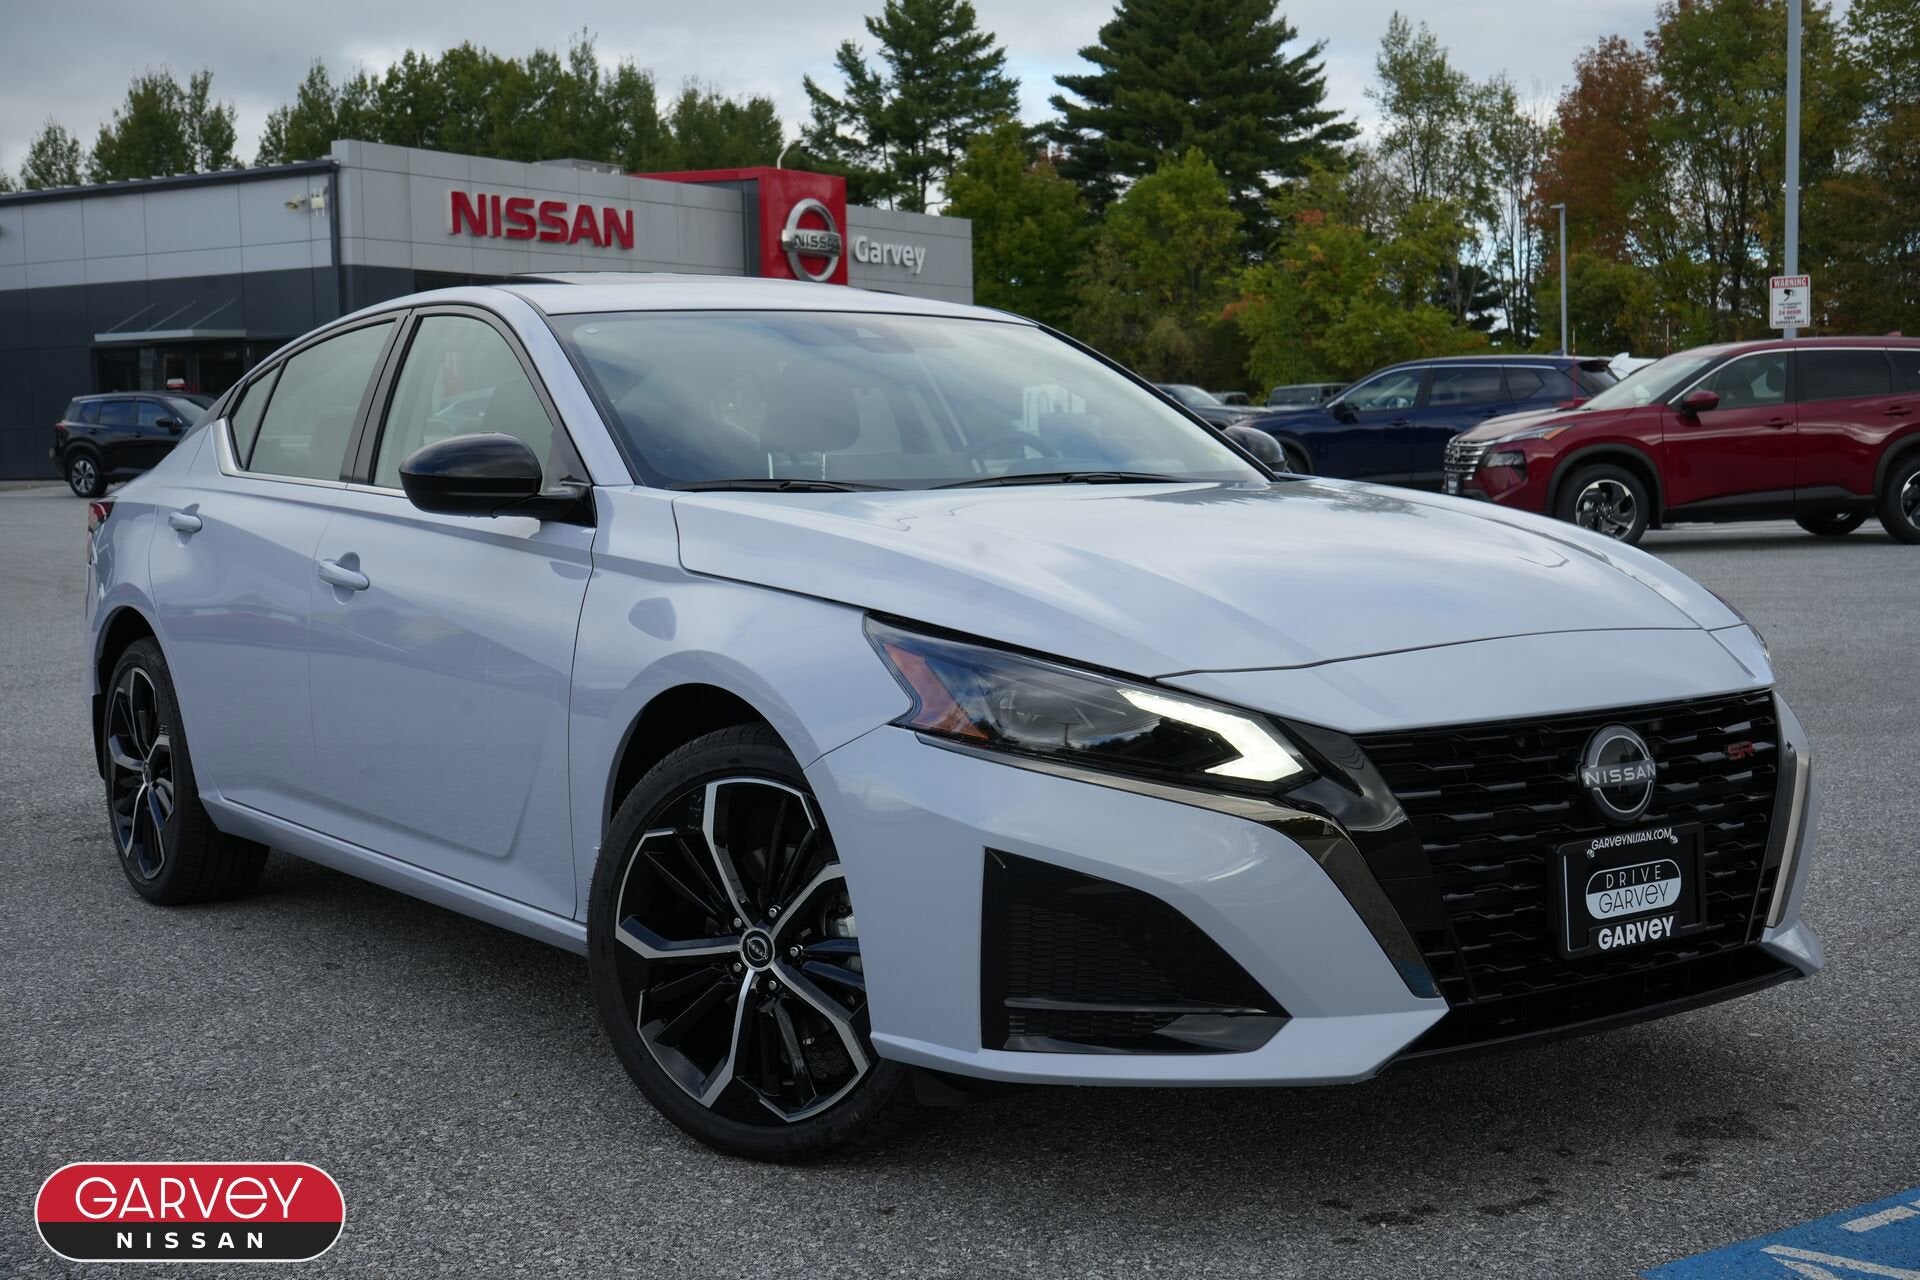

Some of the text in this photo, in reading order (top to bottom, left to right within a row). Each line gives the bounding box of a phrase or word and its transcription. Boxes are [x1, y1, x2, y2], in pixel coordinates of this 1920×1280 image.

[450, 190, 634, 250] NISSAN
[853, 235, 927, 275] Garvey
[1773, 277, 1807, 288] WARNING
[1727, 740, 1754, 760] SR
[1583, 762, 1657, 786] NISSAN
[1605, 864, 1663, 889] DRIVE
